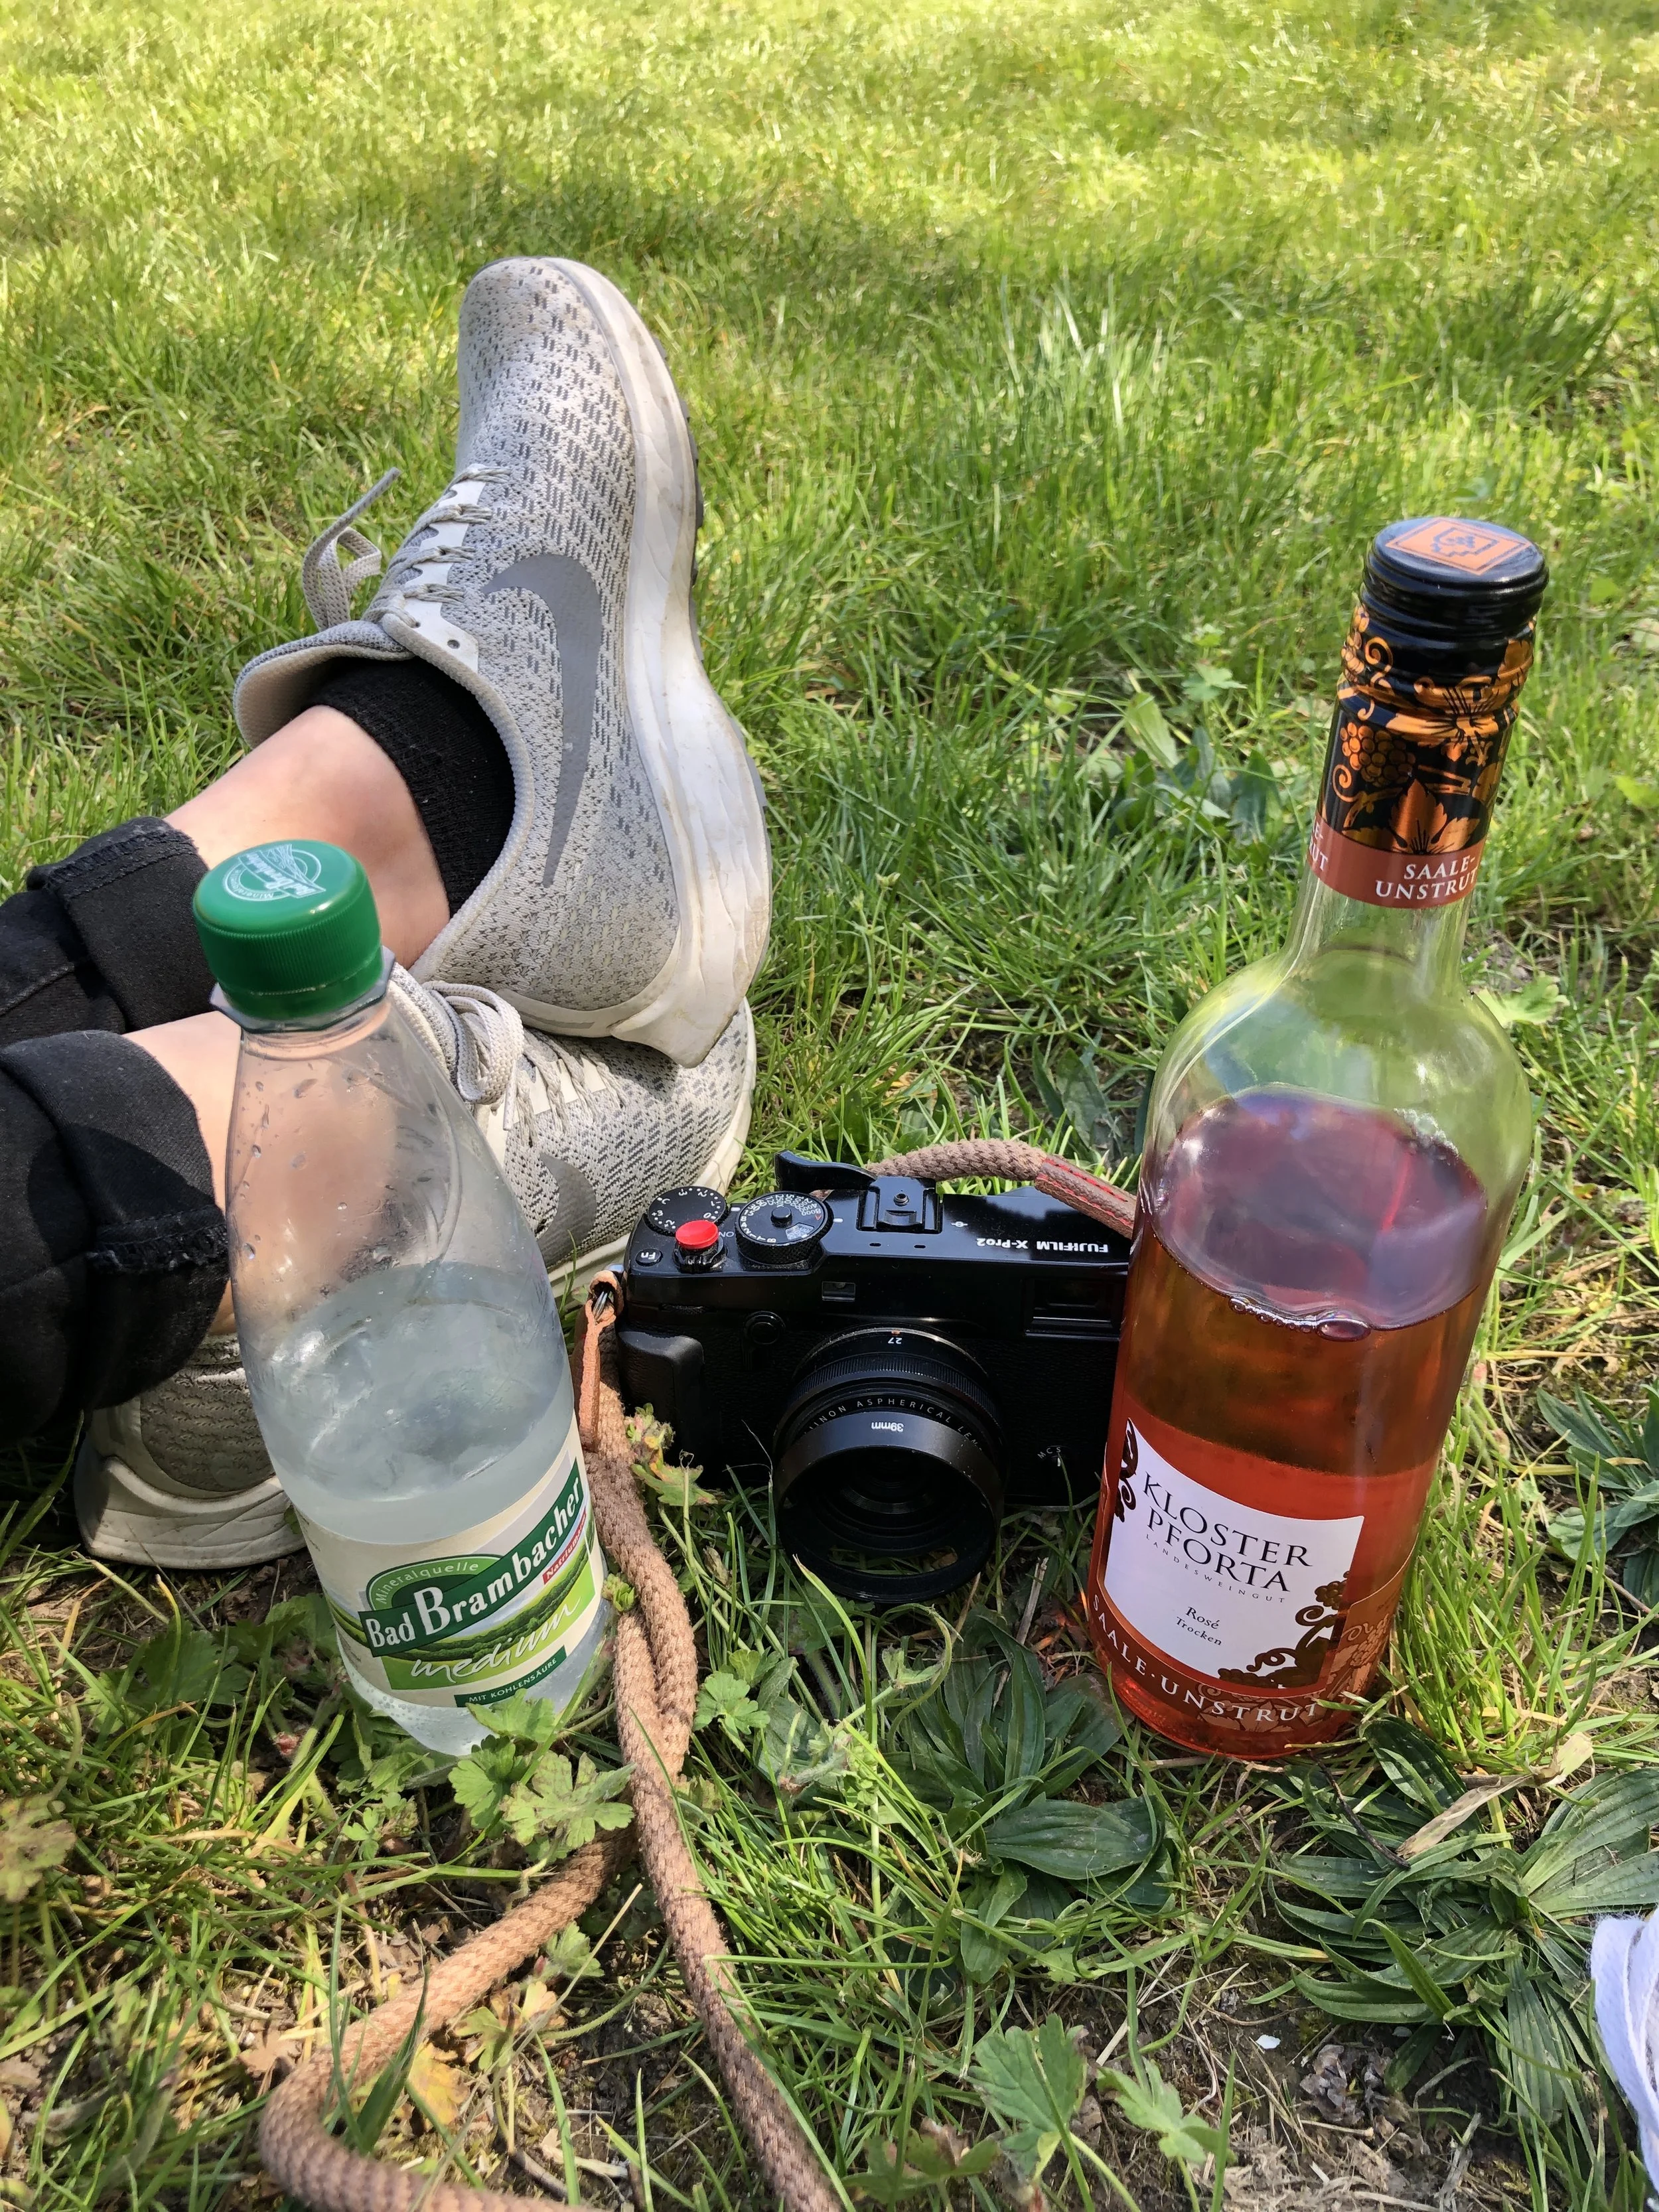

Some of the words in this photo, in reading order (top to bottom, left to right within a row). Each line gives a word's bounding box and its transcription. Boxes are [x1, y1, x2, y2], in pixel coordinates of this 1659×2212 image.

[1375, 865, 1479, 901] UNSTRUT
[1404, 855, 1476, 880] SAALE-
[976, 1238, 1029, 1249] X-Pro2
[1036, 1240, 1109, 1253] FUJIFILM
[857, 1398, 950, 1424] ASPHERICAL
[871, 1421, 904, 1432] 39mm
[1143, 1471, 1313, 1567] KLOSTER
[366, 1611, 416, 1649] Bad
[413, 1477, 579, 1636] Brambacher
[1147, 1505, 1291, 1592] PFORTA
[375, 1561, 480, 1604] Mineralquelle
[1145, 1533, 1285, 1603] LANDESWEINGUT
[1176, 1616, 1222, 1646] Trocken
[1185, 1606, 1222, 1630] Rosé
[410, 1596, 581, 1684] medium
[490, 1657, 557, 1698] KOHLENSÄURE
